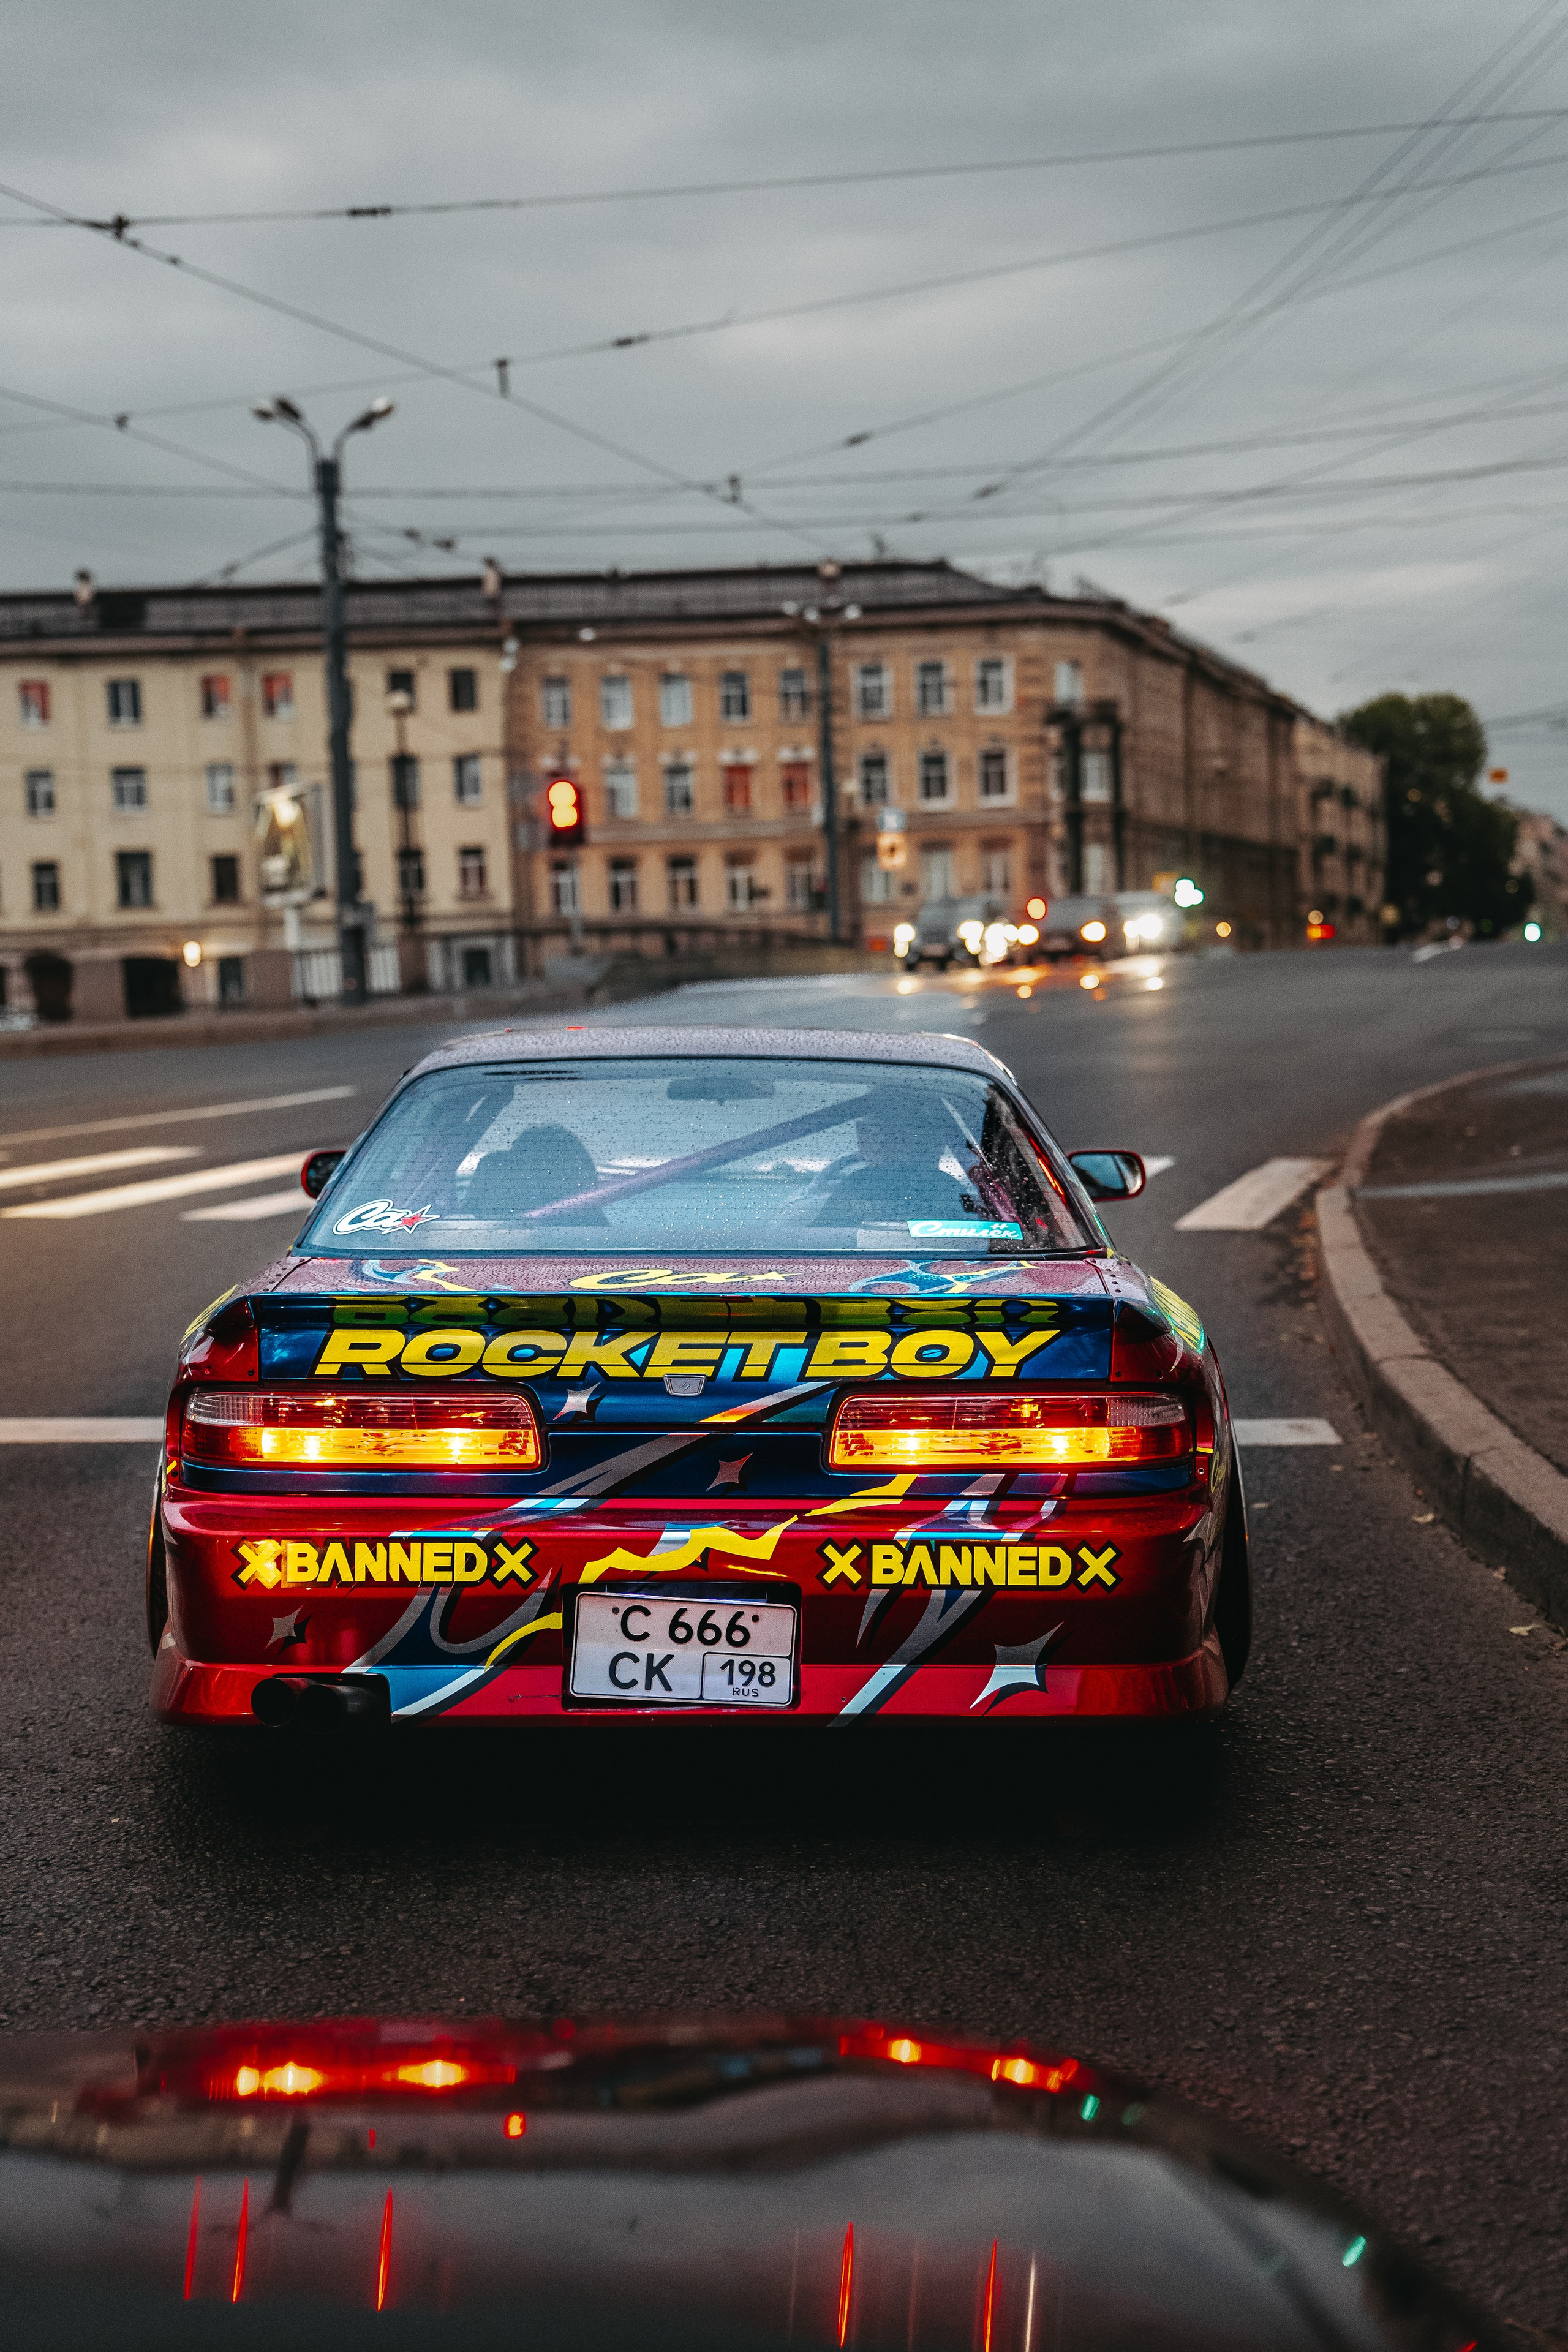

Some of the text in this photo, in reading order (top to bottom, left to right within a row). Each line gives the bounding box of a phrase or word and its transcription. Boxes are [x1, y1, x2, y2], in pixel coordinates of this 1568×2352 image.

[620, 1605, 750, 1648] C 666
[608, 1651, 675, 1692] CK
[719, 1659, 776, 1687] 198
[731, 1687, 760, 1698] RUS
